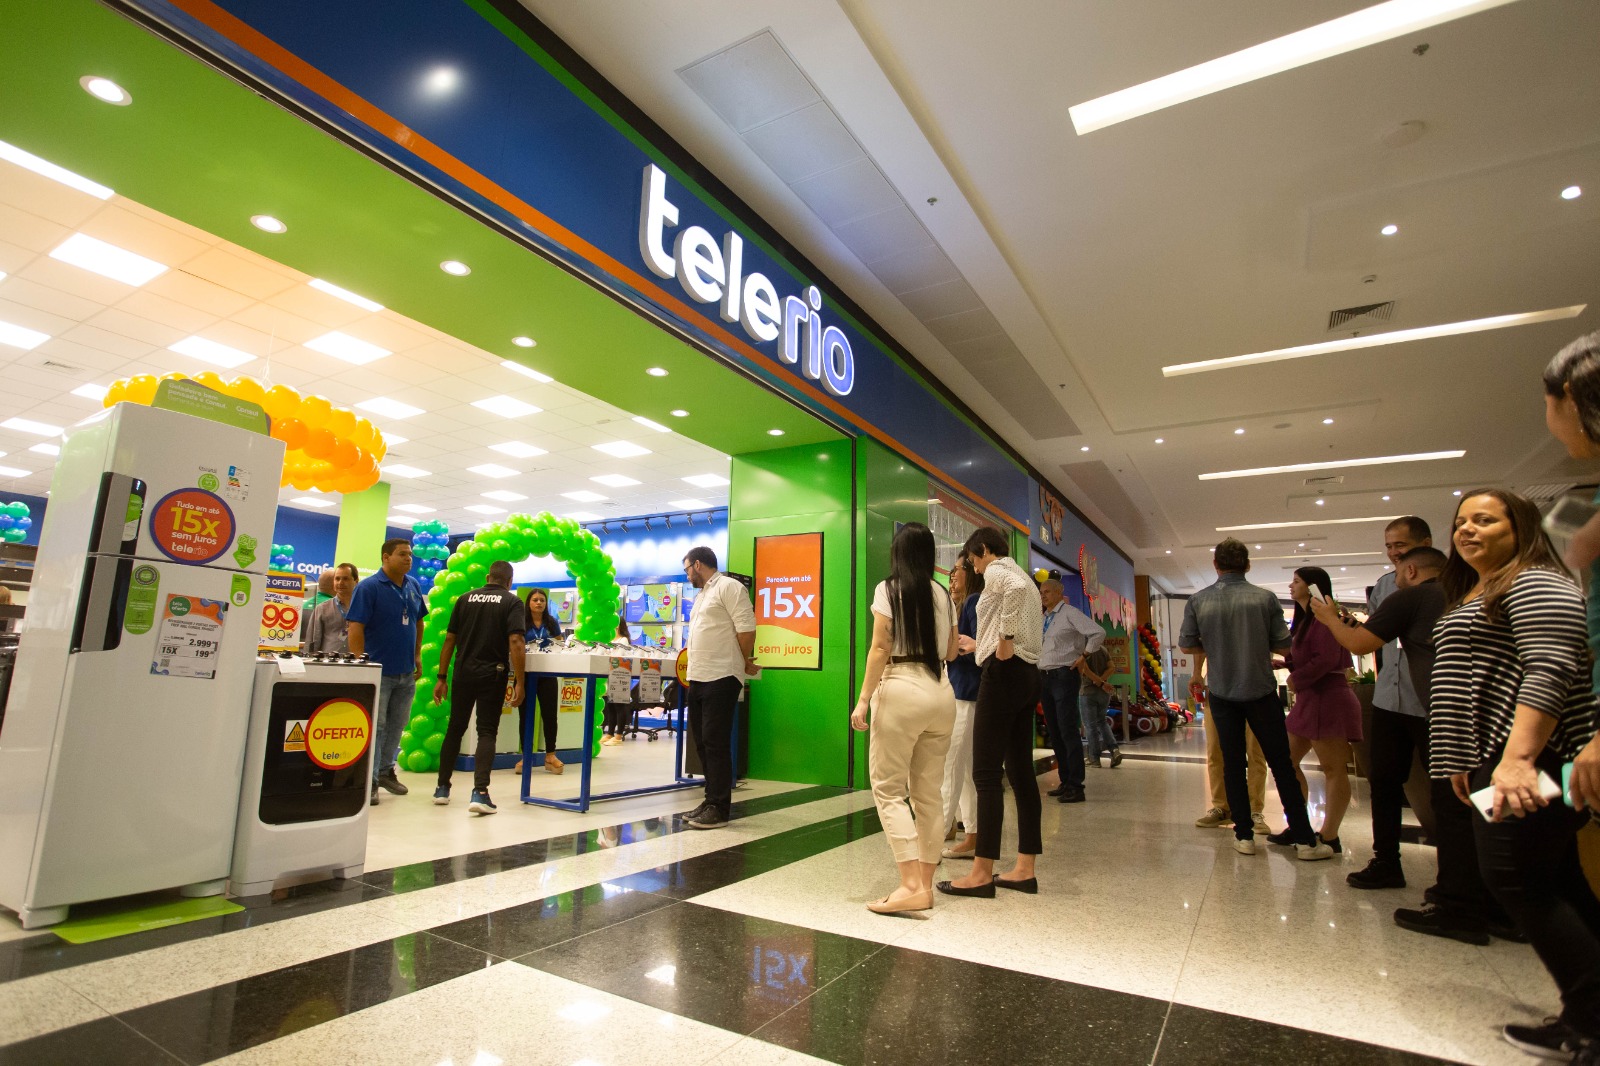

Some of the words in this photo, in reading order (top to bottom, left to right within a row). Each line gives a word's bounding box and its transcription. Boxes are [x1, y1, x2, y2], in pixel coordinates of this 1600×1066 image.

[639, 163, 855, 396] telerio
[236, 405, 259, 417] Consul
[176, 500, 195, 510] Tudo
[196, 505, 207, 513] em
[208, 506, 220, 515] até
[171, 507, 221, 538] 15x
[171, 531, 192, 541] sem
[193, 532, 217, 546] juros
[272, 578, 301, 588] OFERTA
[766, 576, 789, 584] Parcele
[790, 575, 800, 583] em
[801, 574, 812, 582] até
[468, 594, 503, 604] LOCUTOR
[758, 587, 816, 618] 15x
[162, 646, 178, 655] 15X
[758, 645, 781, 654] sem
[783, 643, 813, 656] juros
[312, 727, 365, 741] OFERTA
